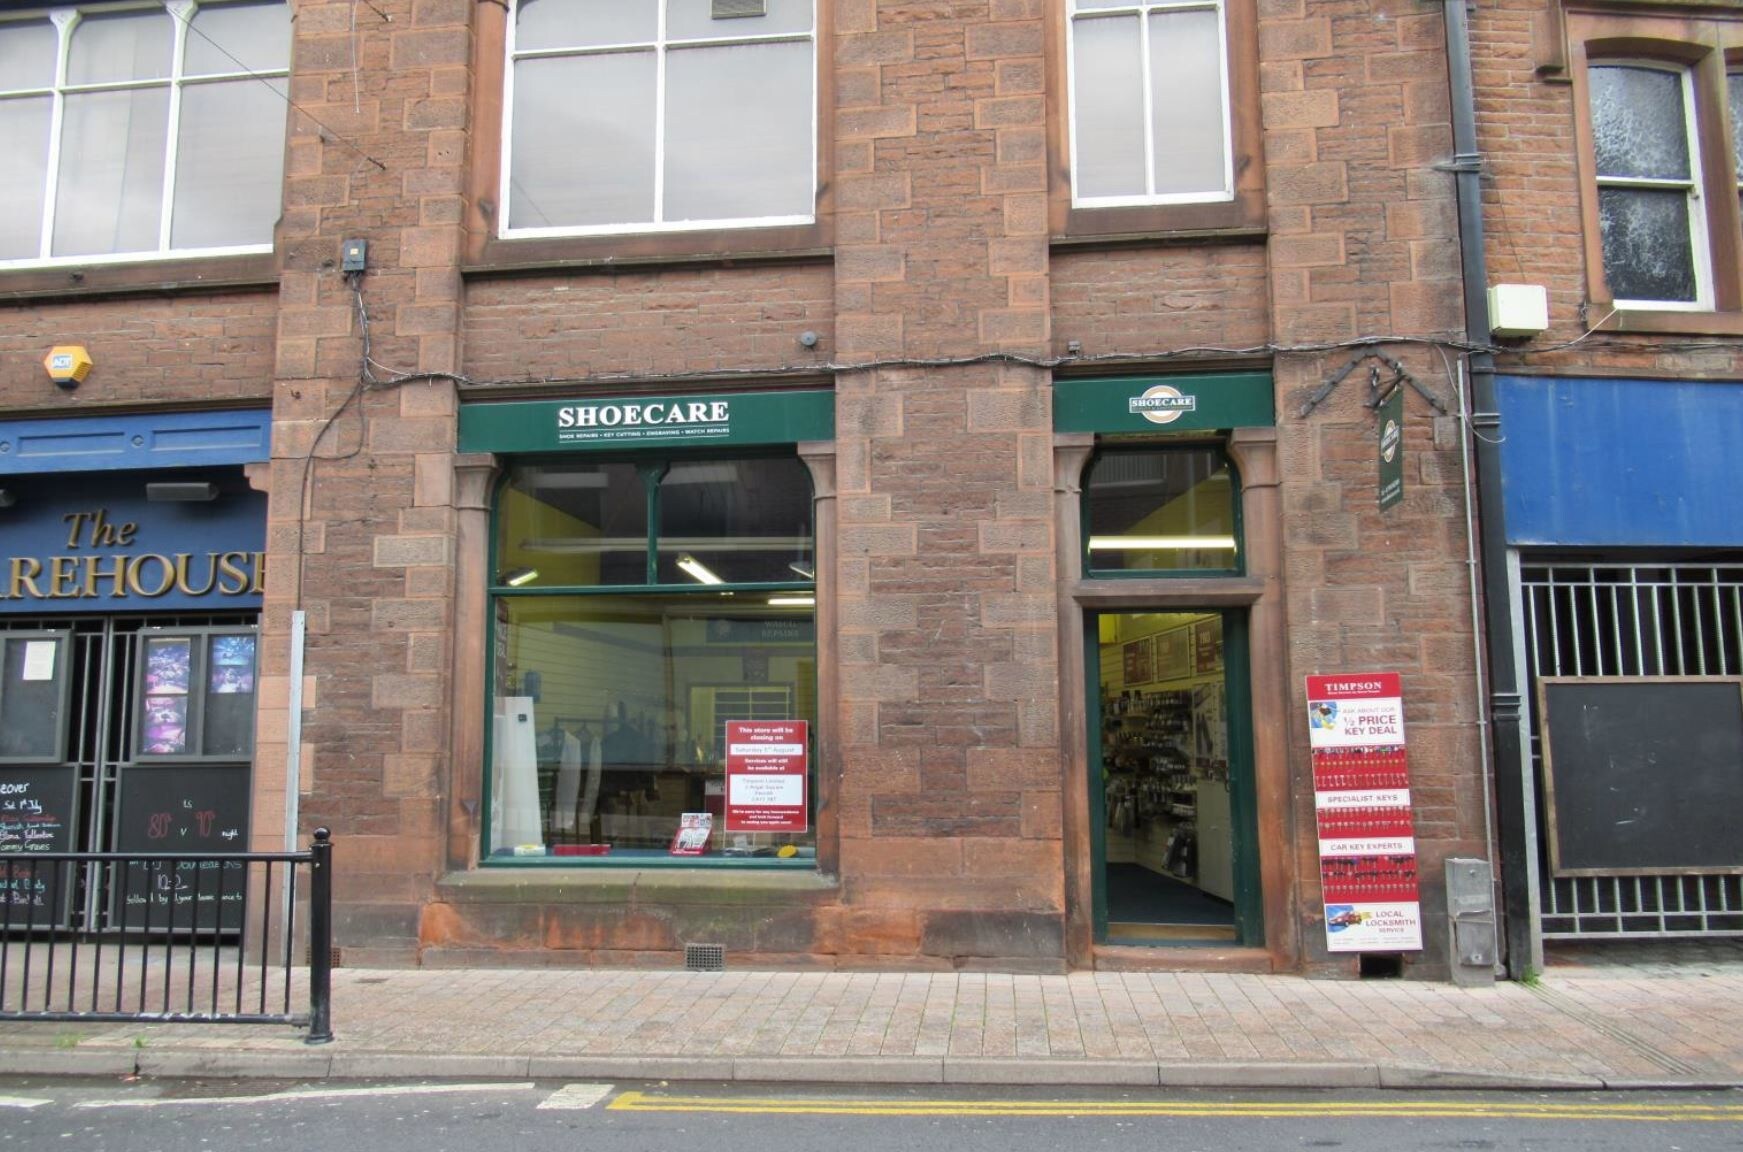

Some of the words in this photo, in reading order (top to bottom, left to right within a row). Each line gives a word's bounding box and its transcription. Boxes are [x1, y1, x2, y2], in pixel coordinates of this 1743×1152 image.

[1132, 398, 1191, 407] SHOECARE
[559, 402, 730, 427] SHOECARE
[62, 509, 138, 548] The
[0, 551, 265, 599] REHOUS
[1324, 681, 1382, 692] TIMPSON
[1358, 715, 1396, 726] PRICE
[1344, 726, 1366, 736] KEY
[1369, 726, 1398, 734] DEAL
